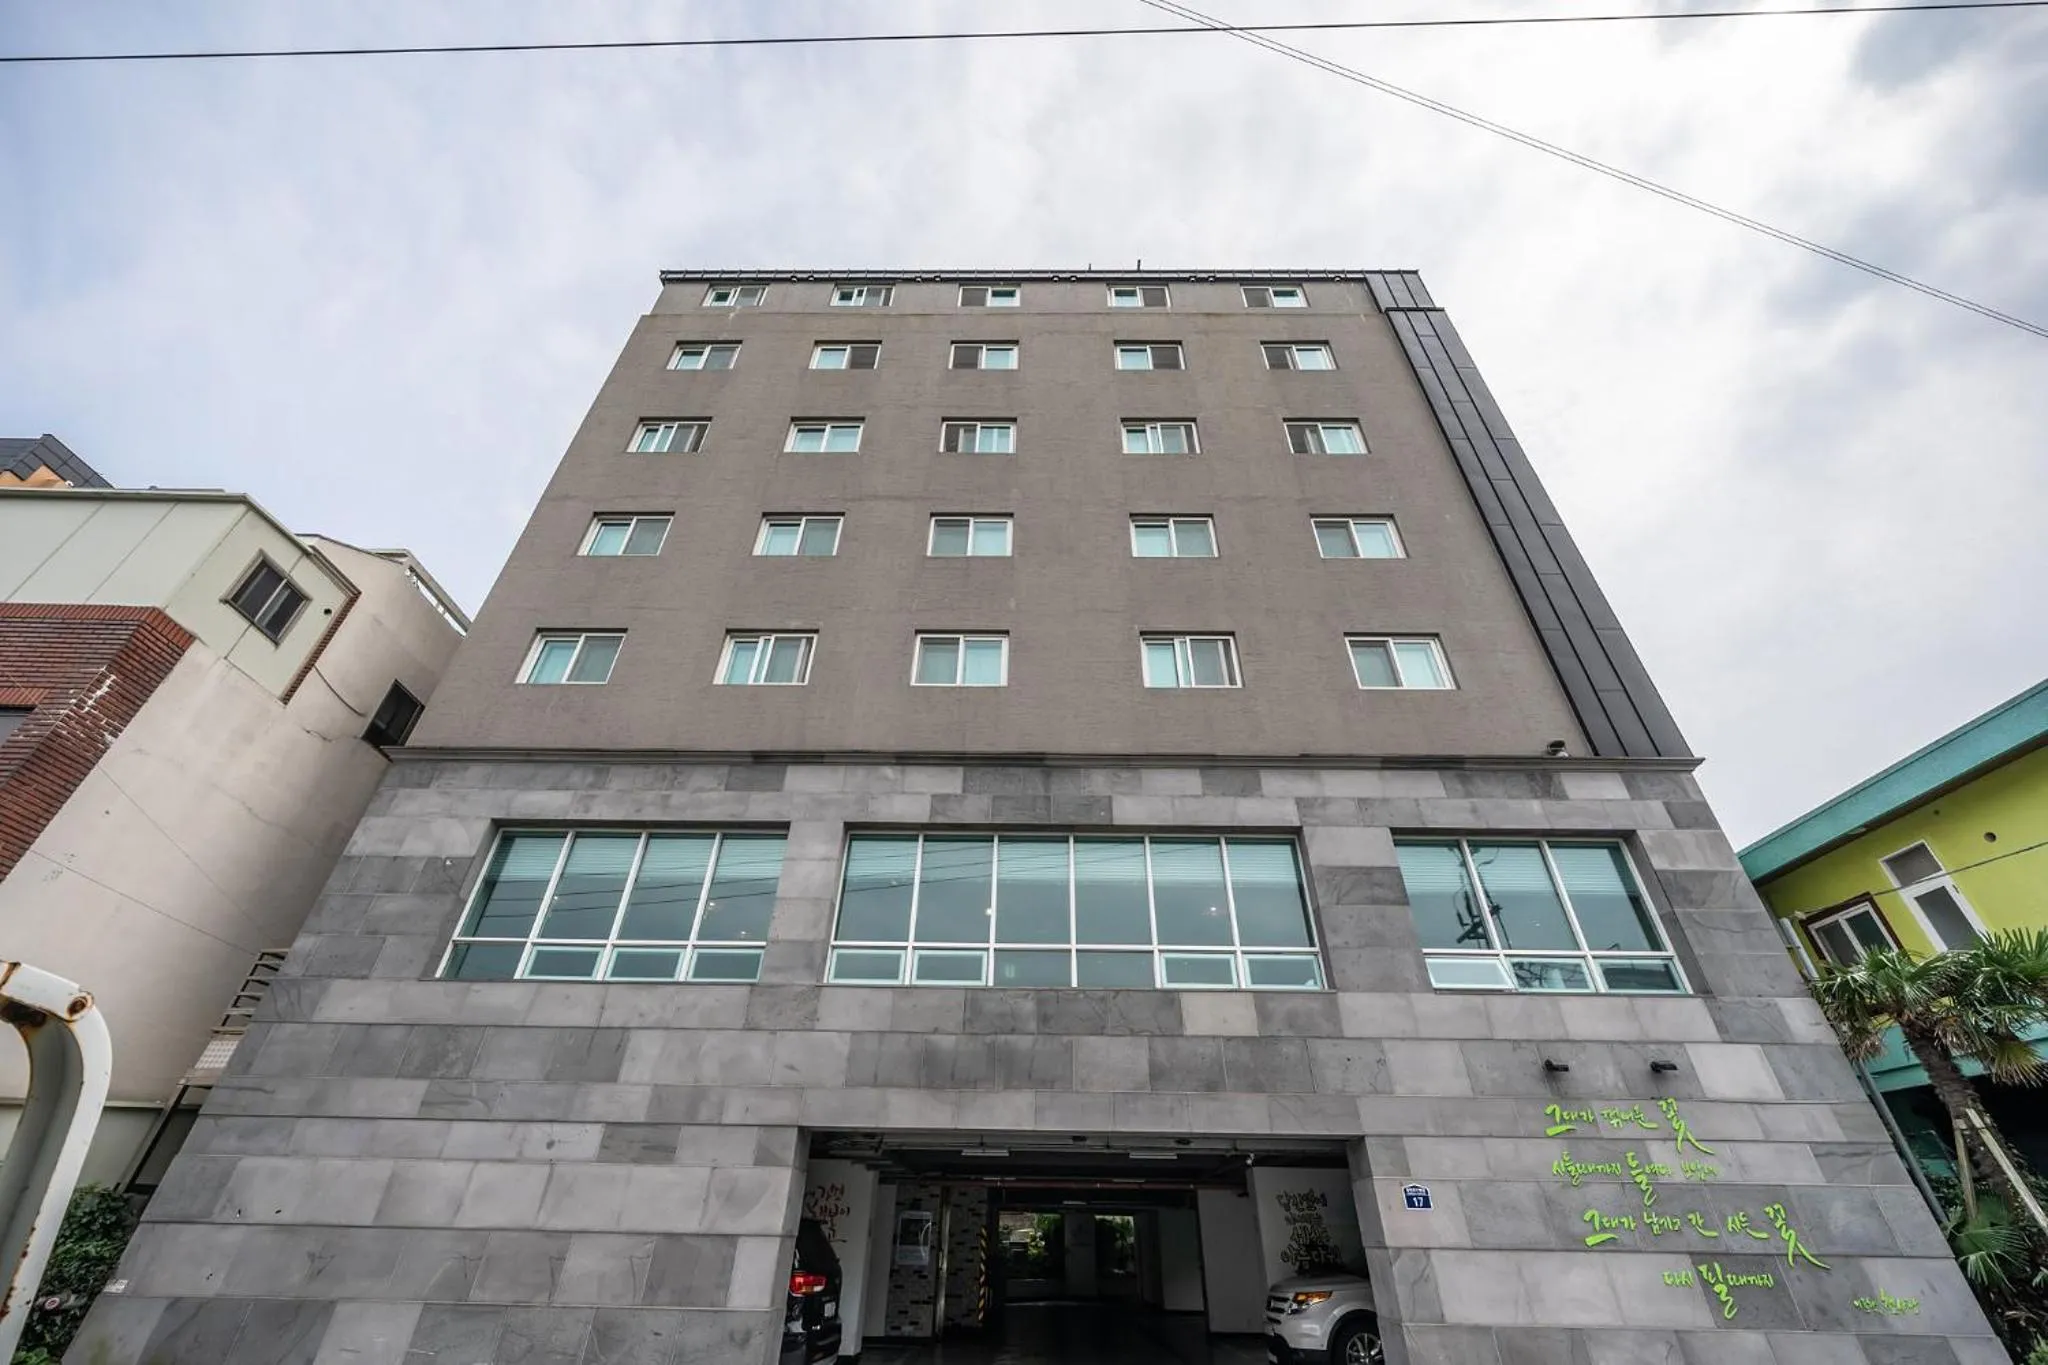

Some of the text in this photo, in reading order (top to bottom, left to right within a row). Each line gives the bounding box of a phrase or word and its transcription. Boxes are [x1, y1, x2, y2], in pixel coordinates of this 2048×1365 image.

[1544, 1103, 1595, 1137] 그대가
[1657, 1096, 1716, 1155] 꽃
[1412, 1196, 1424, 1208] 17
[1583, 1202, 1832, 1270] 그대가 남기고 간 시든 꽃
[1662, 1270, 1694, 1288] 다시
